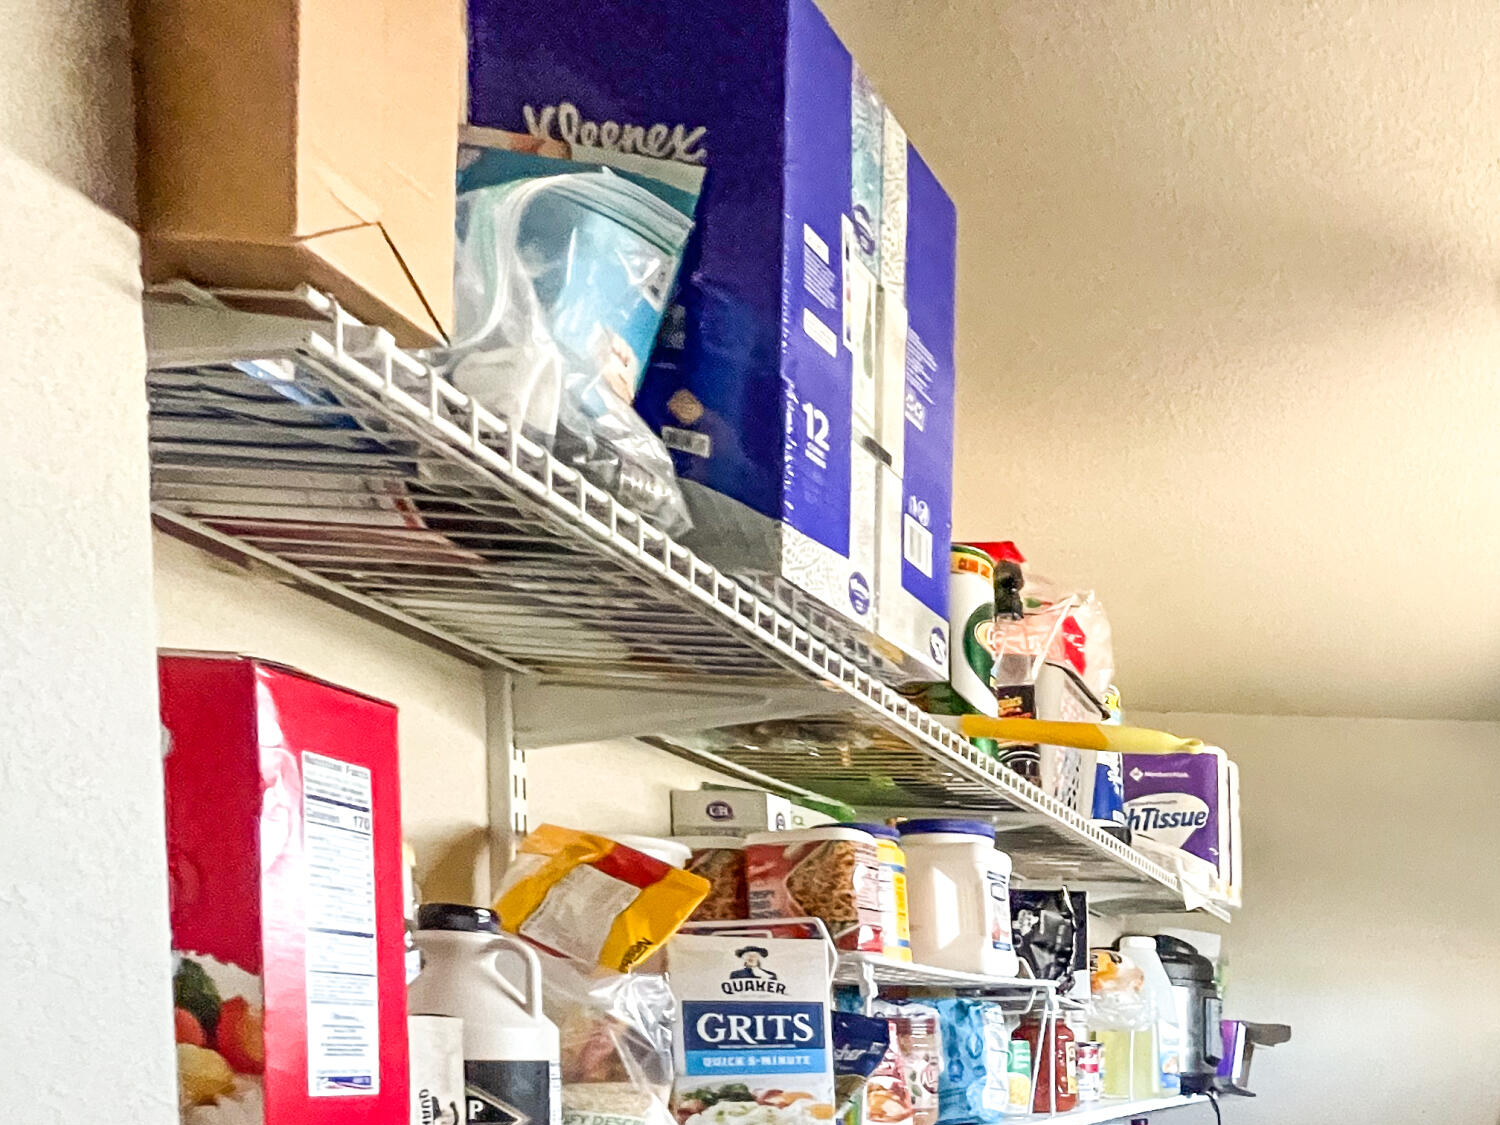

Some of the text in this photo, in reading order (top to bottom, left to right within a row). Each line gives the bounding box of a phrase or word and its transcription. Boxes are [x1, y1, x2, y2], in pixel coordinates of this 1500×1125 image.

[523, 102, 707, 161] Kleenex
[802, 402, 830, 451] 12
[1126, 807, 1206, 831] hTissue
[721, 979, 787, 995] QUAKER
[696, 1012, 814, 1045] GRITS
[702, 1055, 744, 1068] QUICK
